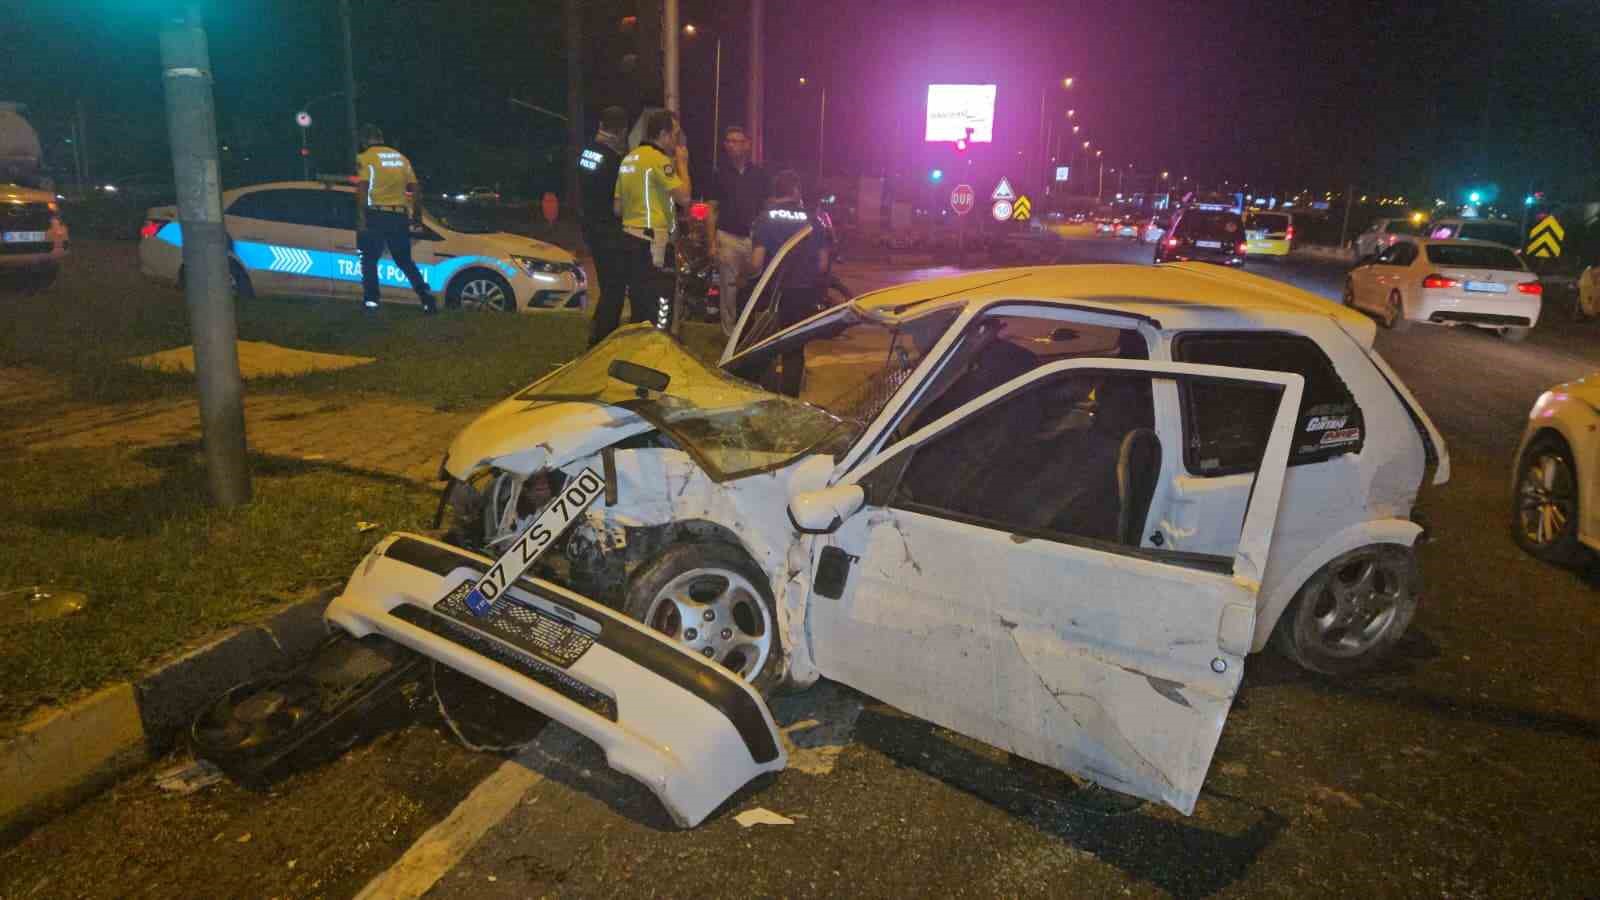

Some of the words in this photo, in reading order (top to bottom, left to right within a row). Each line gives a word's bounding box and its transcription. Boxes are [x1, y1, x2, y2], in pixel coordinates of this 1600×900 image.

[479, 563, 507, 600] 07
[512, 523, 553, 565] ZS
[551, 474, 600, 522] 700
